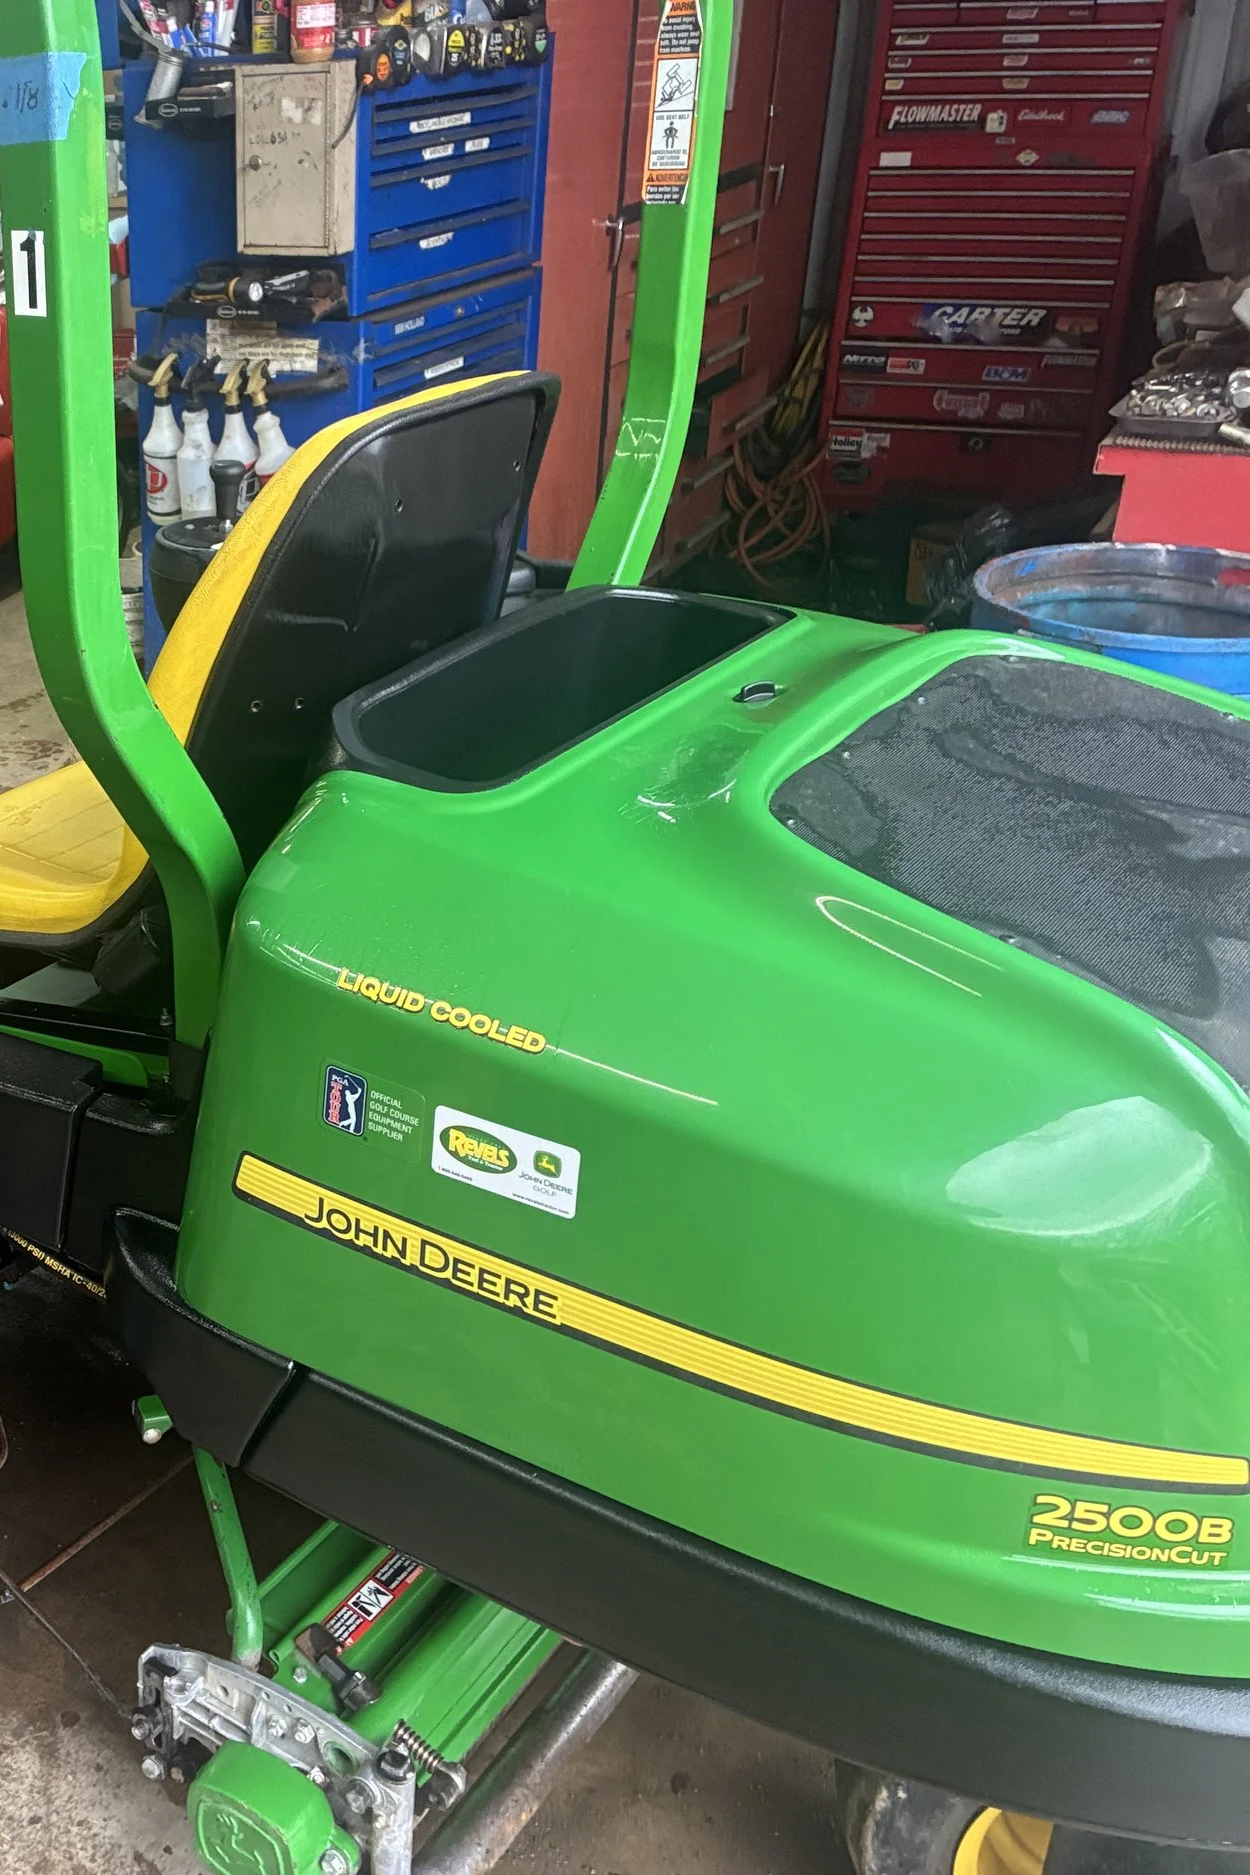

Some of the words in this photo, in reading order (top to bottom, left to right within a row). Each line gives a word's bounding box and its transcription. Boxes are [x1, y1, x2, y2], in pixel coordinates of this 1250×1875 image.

[888, 103, 982, 130] FLOWMASTER
[20, 230, 38, 309] 1
[930, 305, 1047, 326] CARTER
[337, 967, 426, 1013] LIQUID
[430, 1000, 547, 1054] COOLED
[332, 1074, 349, 1086] PGA
[329, 1082, 343, 1124] TOUR
[370, 1090, 402, 1109] OFFICIAL
[369, 1111, 413, 1134] EQUIPMENT
[370, 1101, 388, 1113] GOLF
[389, 1107, 419, 1126] COURSE
[368, 1121, 403, 1141] SUPPLIER
[449, 1128, 510, 1168] REVELS
[518, 1171, 542, 1185] JOHN
[543, 1179, 573, 1195] DEERE
[532, 1185, 557, 1197] GOLF
[27, 1244, 46, 1260] PSI)
[44, 1255, 70, 1279] MSHA
[72, 1272, 107, 1299] IC-40/2
[304, 1197, 408, 1260] JOHN
[419, 1238, 559, 1319] DEERE
[1031, 1494, 1235, 1544] 2500B
[1028, 1528, 1227, 1567] PRECISIONCUT
